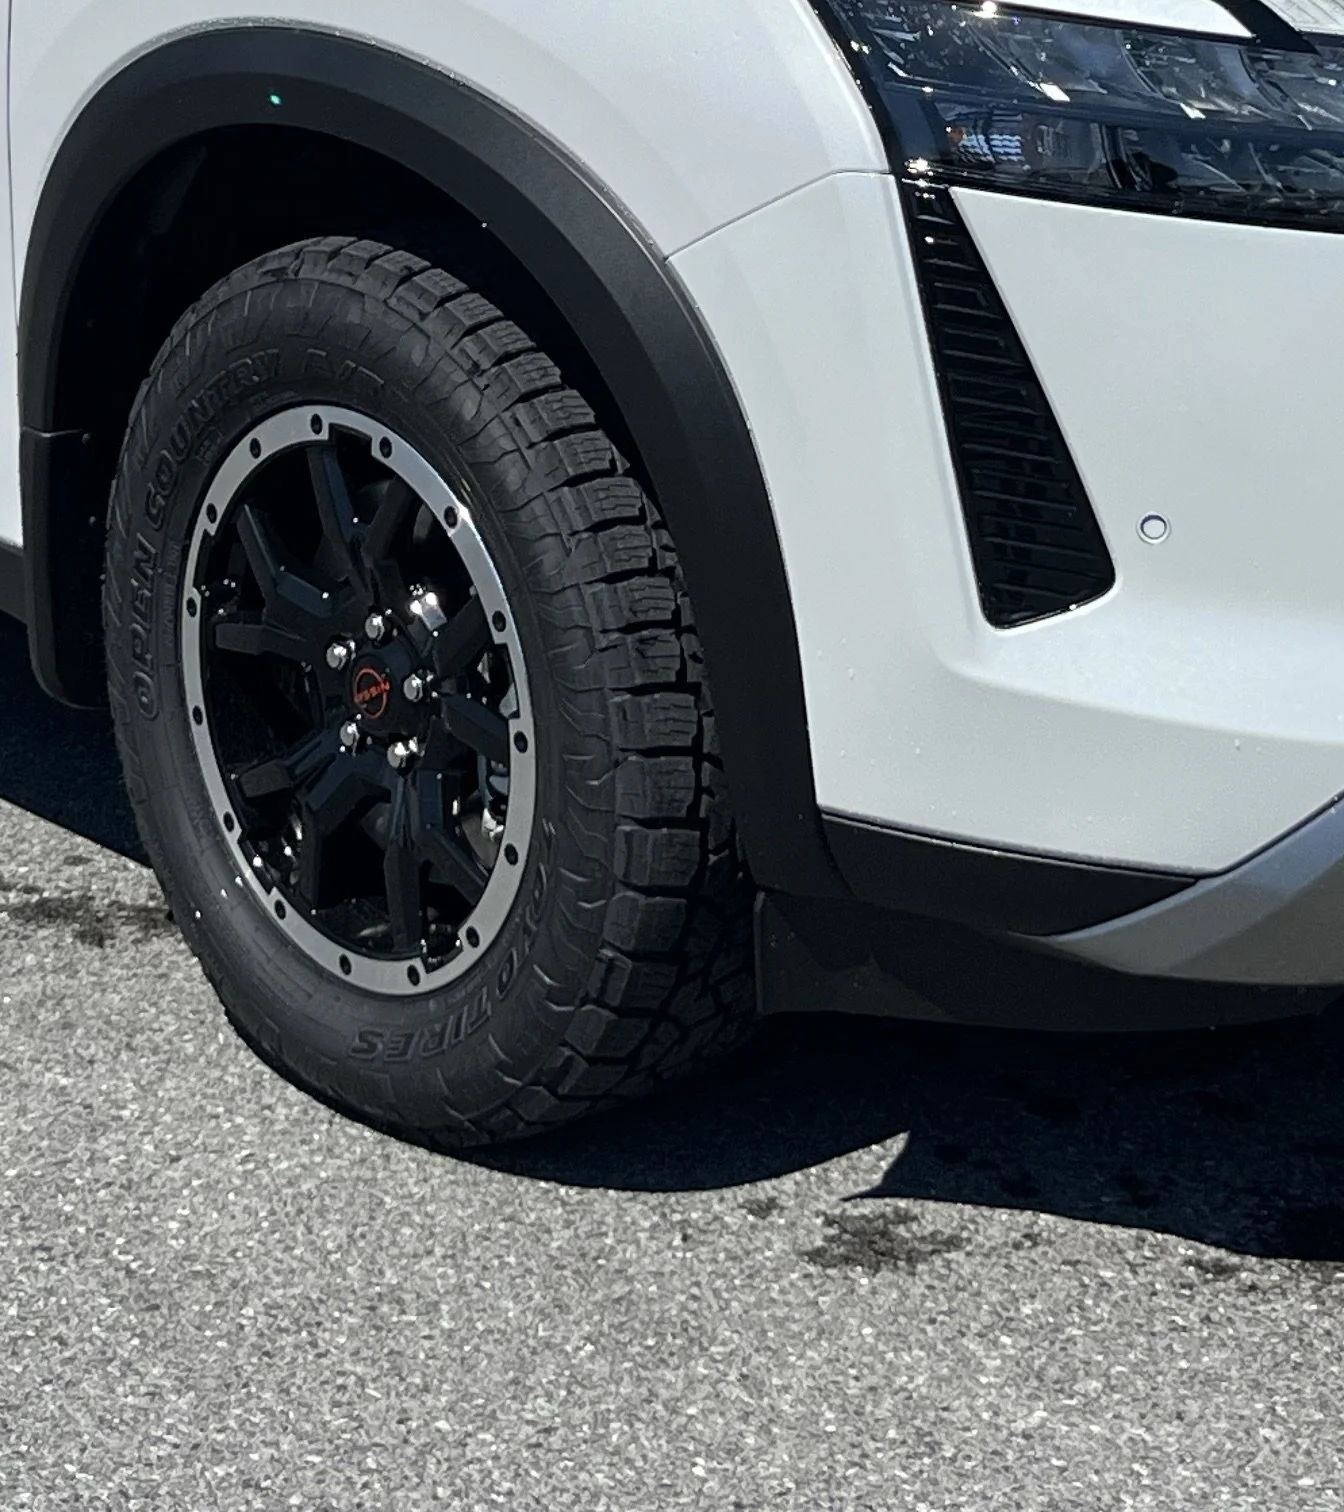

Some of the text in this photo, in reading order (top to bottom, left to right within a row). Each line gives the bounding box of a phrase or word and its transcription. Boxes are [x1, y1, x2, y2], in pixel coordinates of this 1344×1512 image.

[130, 531, 158, 720] OPEN
[144, 347, 281, 531] COUNTRY
[348, 984, 493, 1063] TIRES
